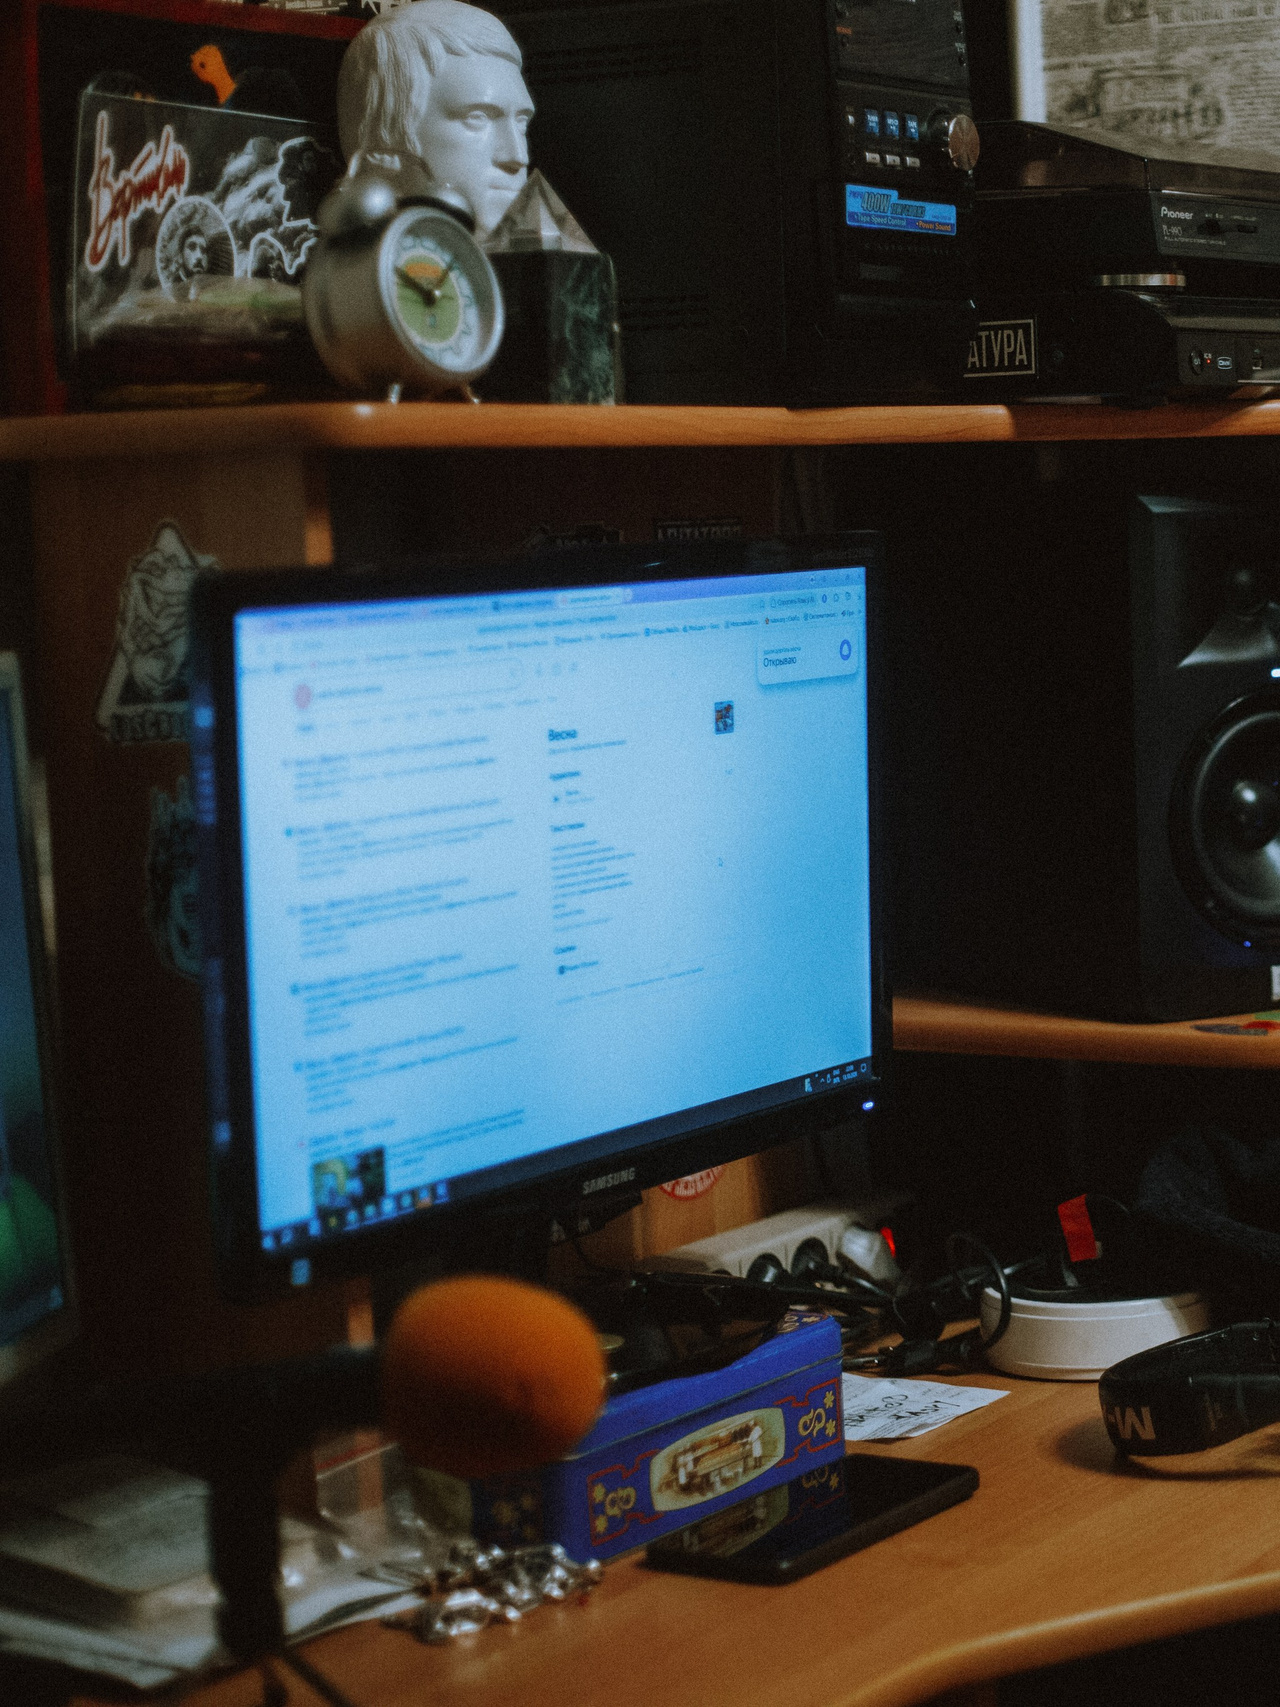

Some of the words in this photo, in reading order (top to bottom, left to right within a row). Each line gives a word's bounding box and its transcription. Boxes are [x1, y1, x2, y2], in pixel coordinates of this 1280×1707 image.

[1160, 206, 1194, 220] Pioneer
[763, 657, 797, 667] Открываю
[583, 1166, 636, 1196] SAMSUNG
